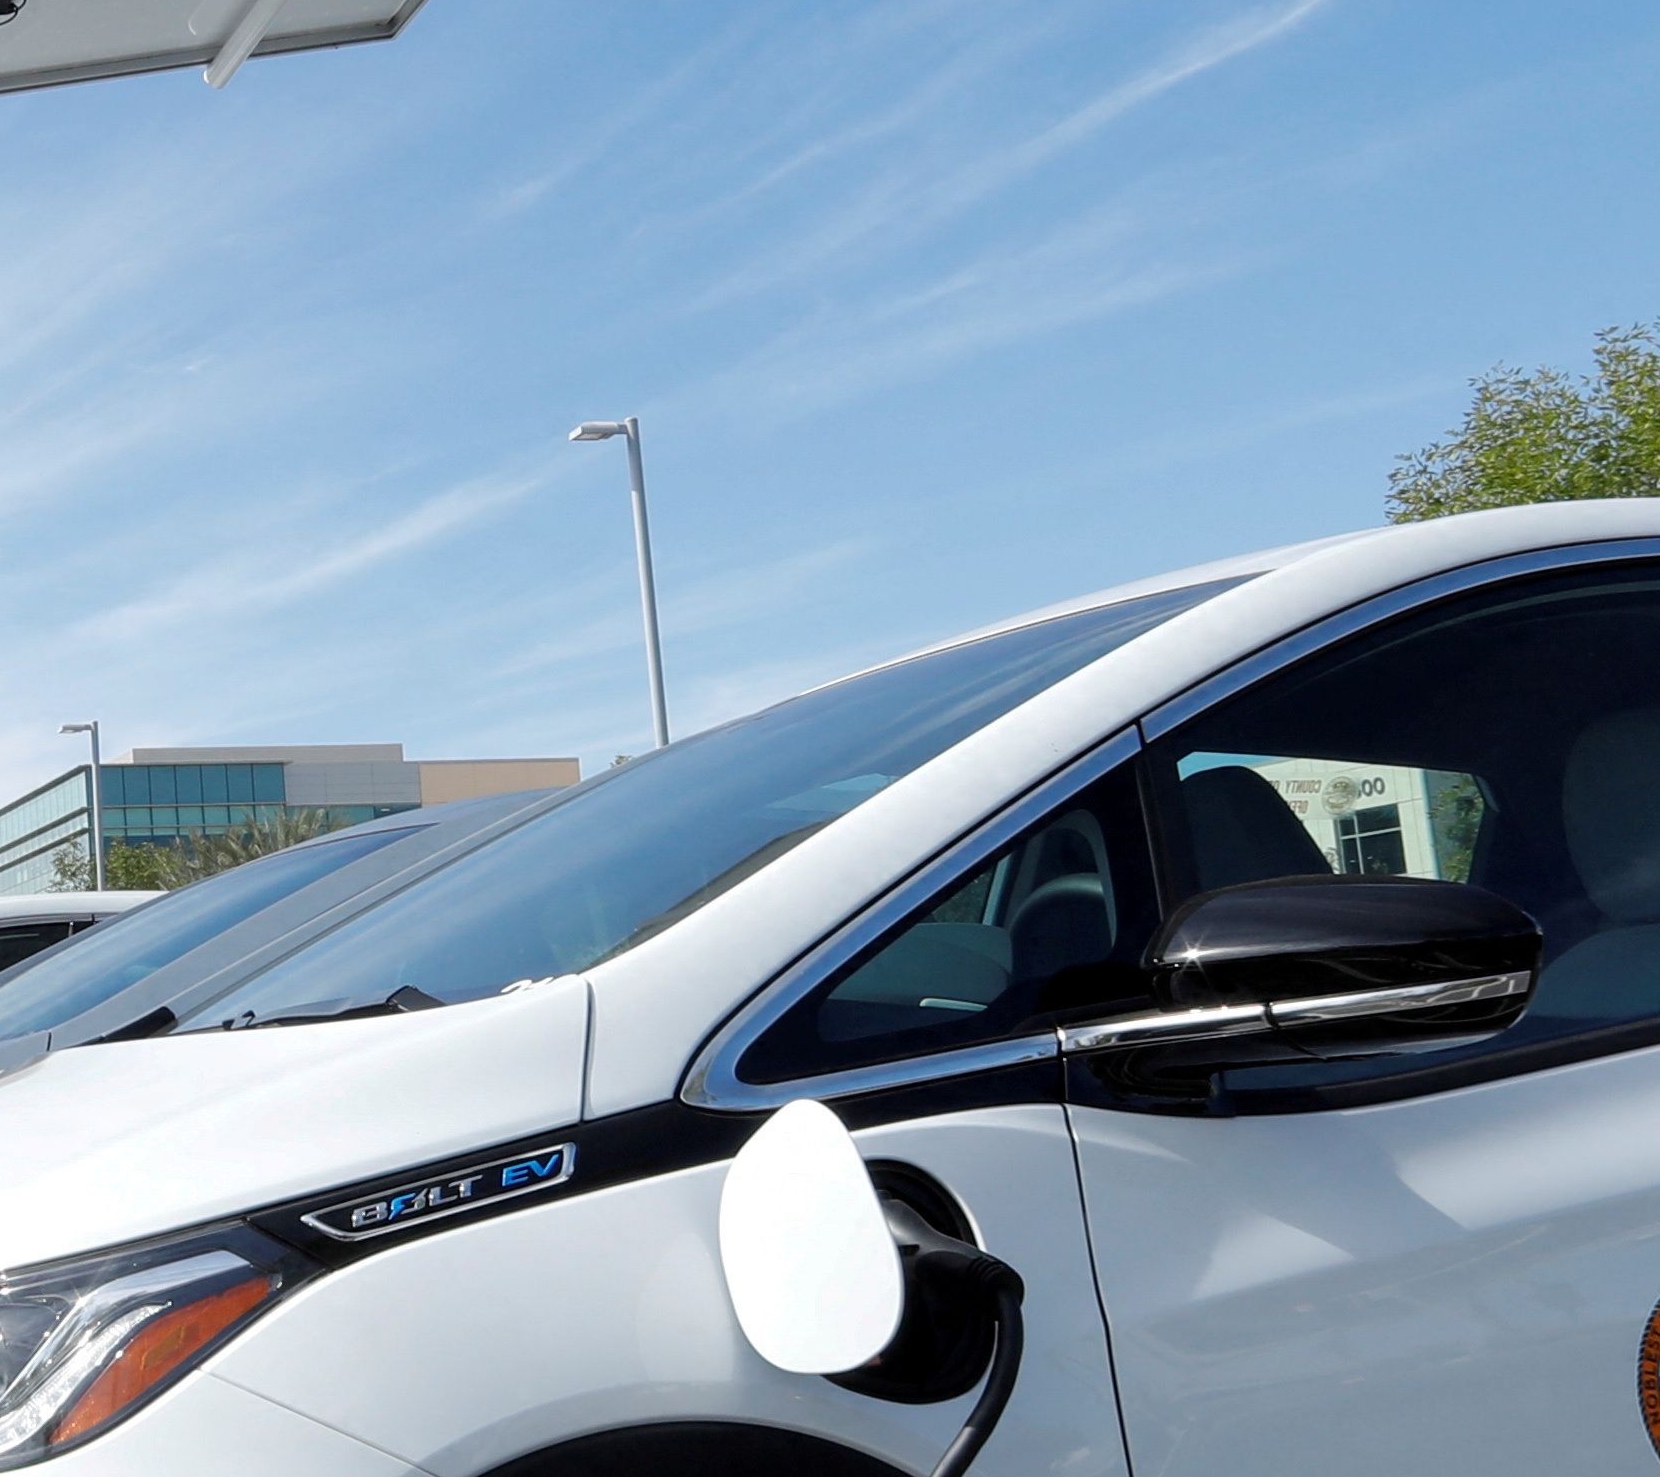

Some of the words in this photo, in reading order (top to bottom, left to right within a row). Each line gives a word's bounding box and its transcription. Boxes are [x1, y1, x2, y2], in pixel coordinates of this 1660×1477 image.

[1356, 777, 1385, 799] 00
[352, 1174, 483, 1228] BOLT
[502, 1153, 559, 1187] EV
